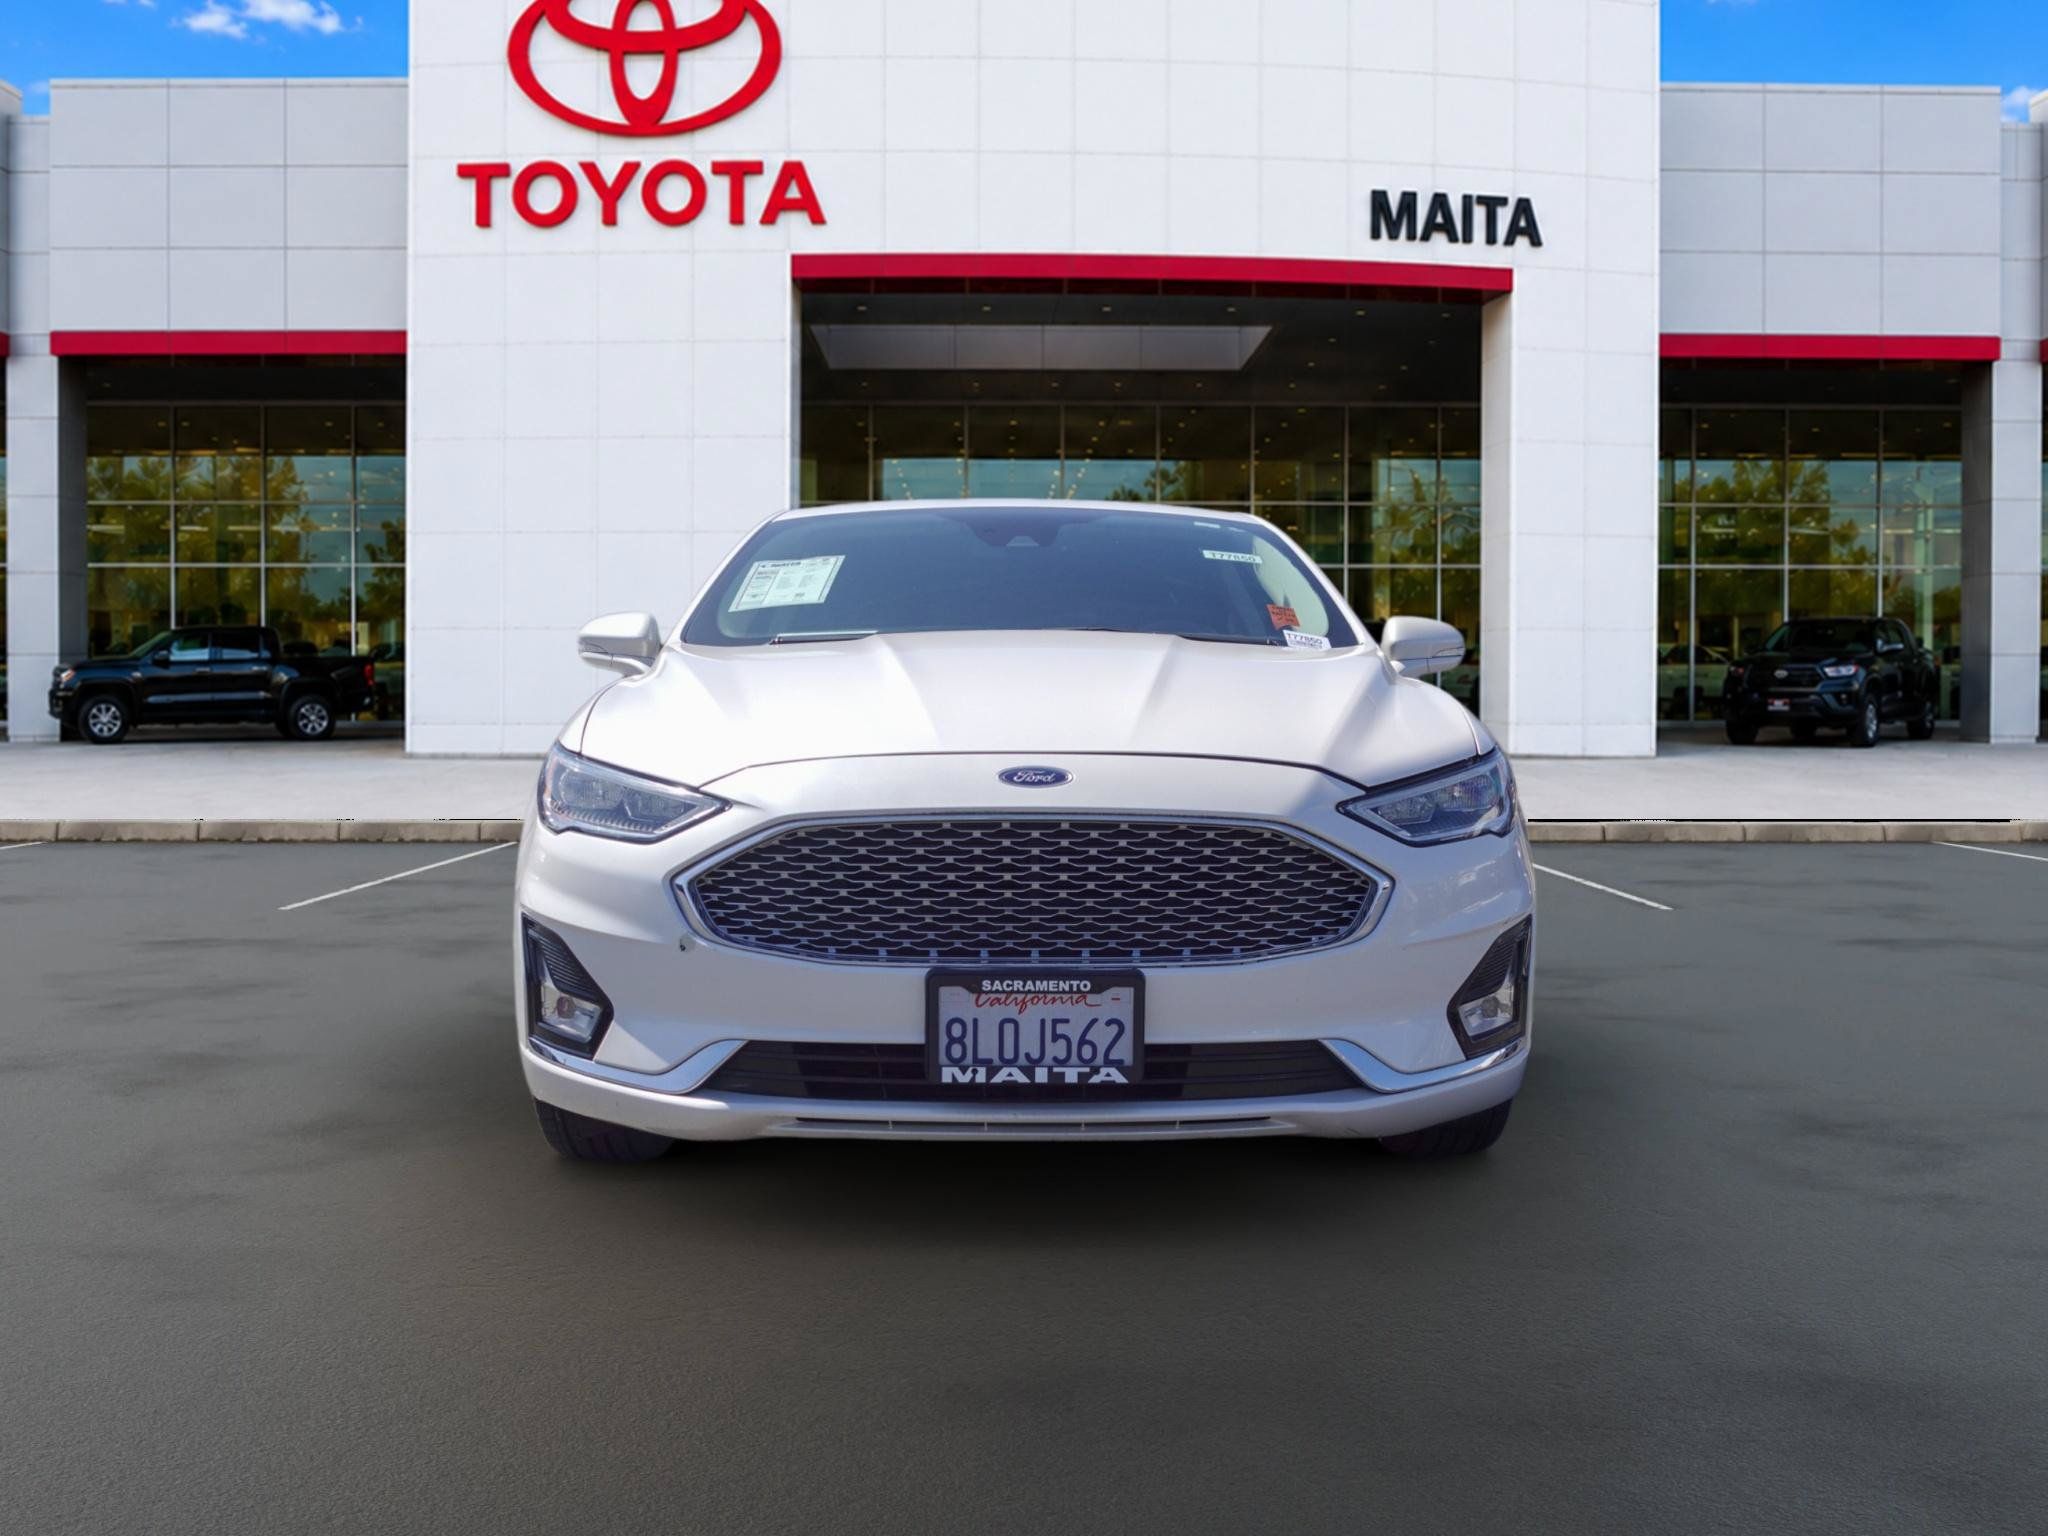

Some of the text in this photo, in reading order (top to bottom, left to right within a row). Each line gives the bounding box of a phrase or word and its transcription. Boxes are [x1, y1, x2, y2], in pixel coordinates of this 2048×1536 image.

[457, 160, 827, 228] TOYOTA
[1370, 189, 1543, 248] MAITA
[1013, 770, 1056, 783] Ford
[981, 980, 1091, 992] SACRAMENTO
[974, 992, 1102, 1015] California
[941, 1066, 1129, 1084] MAITA
